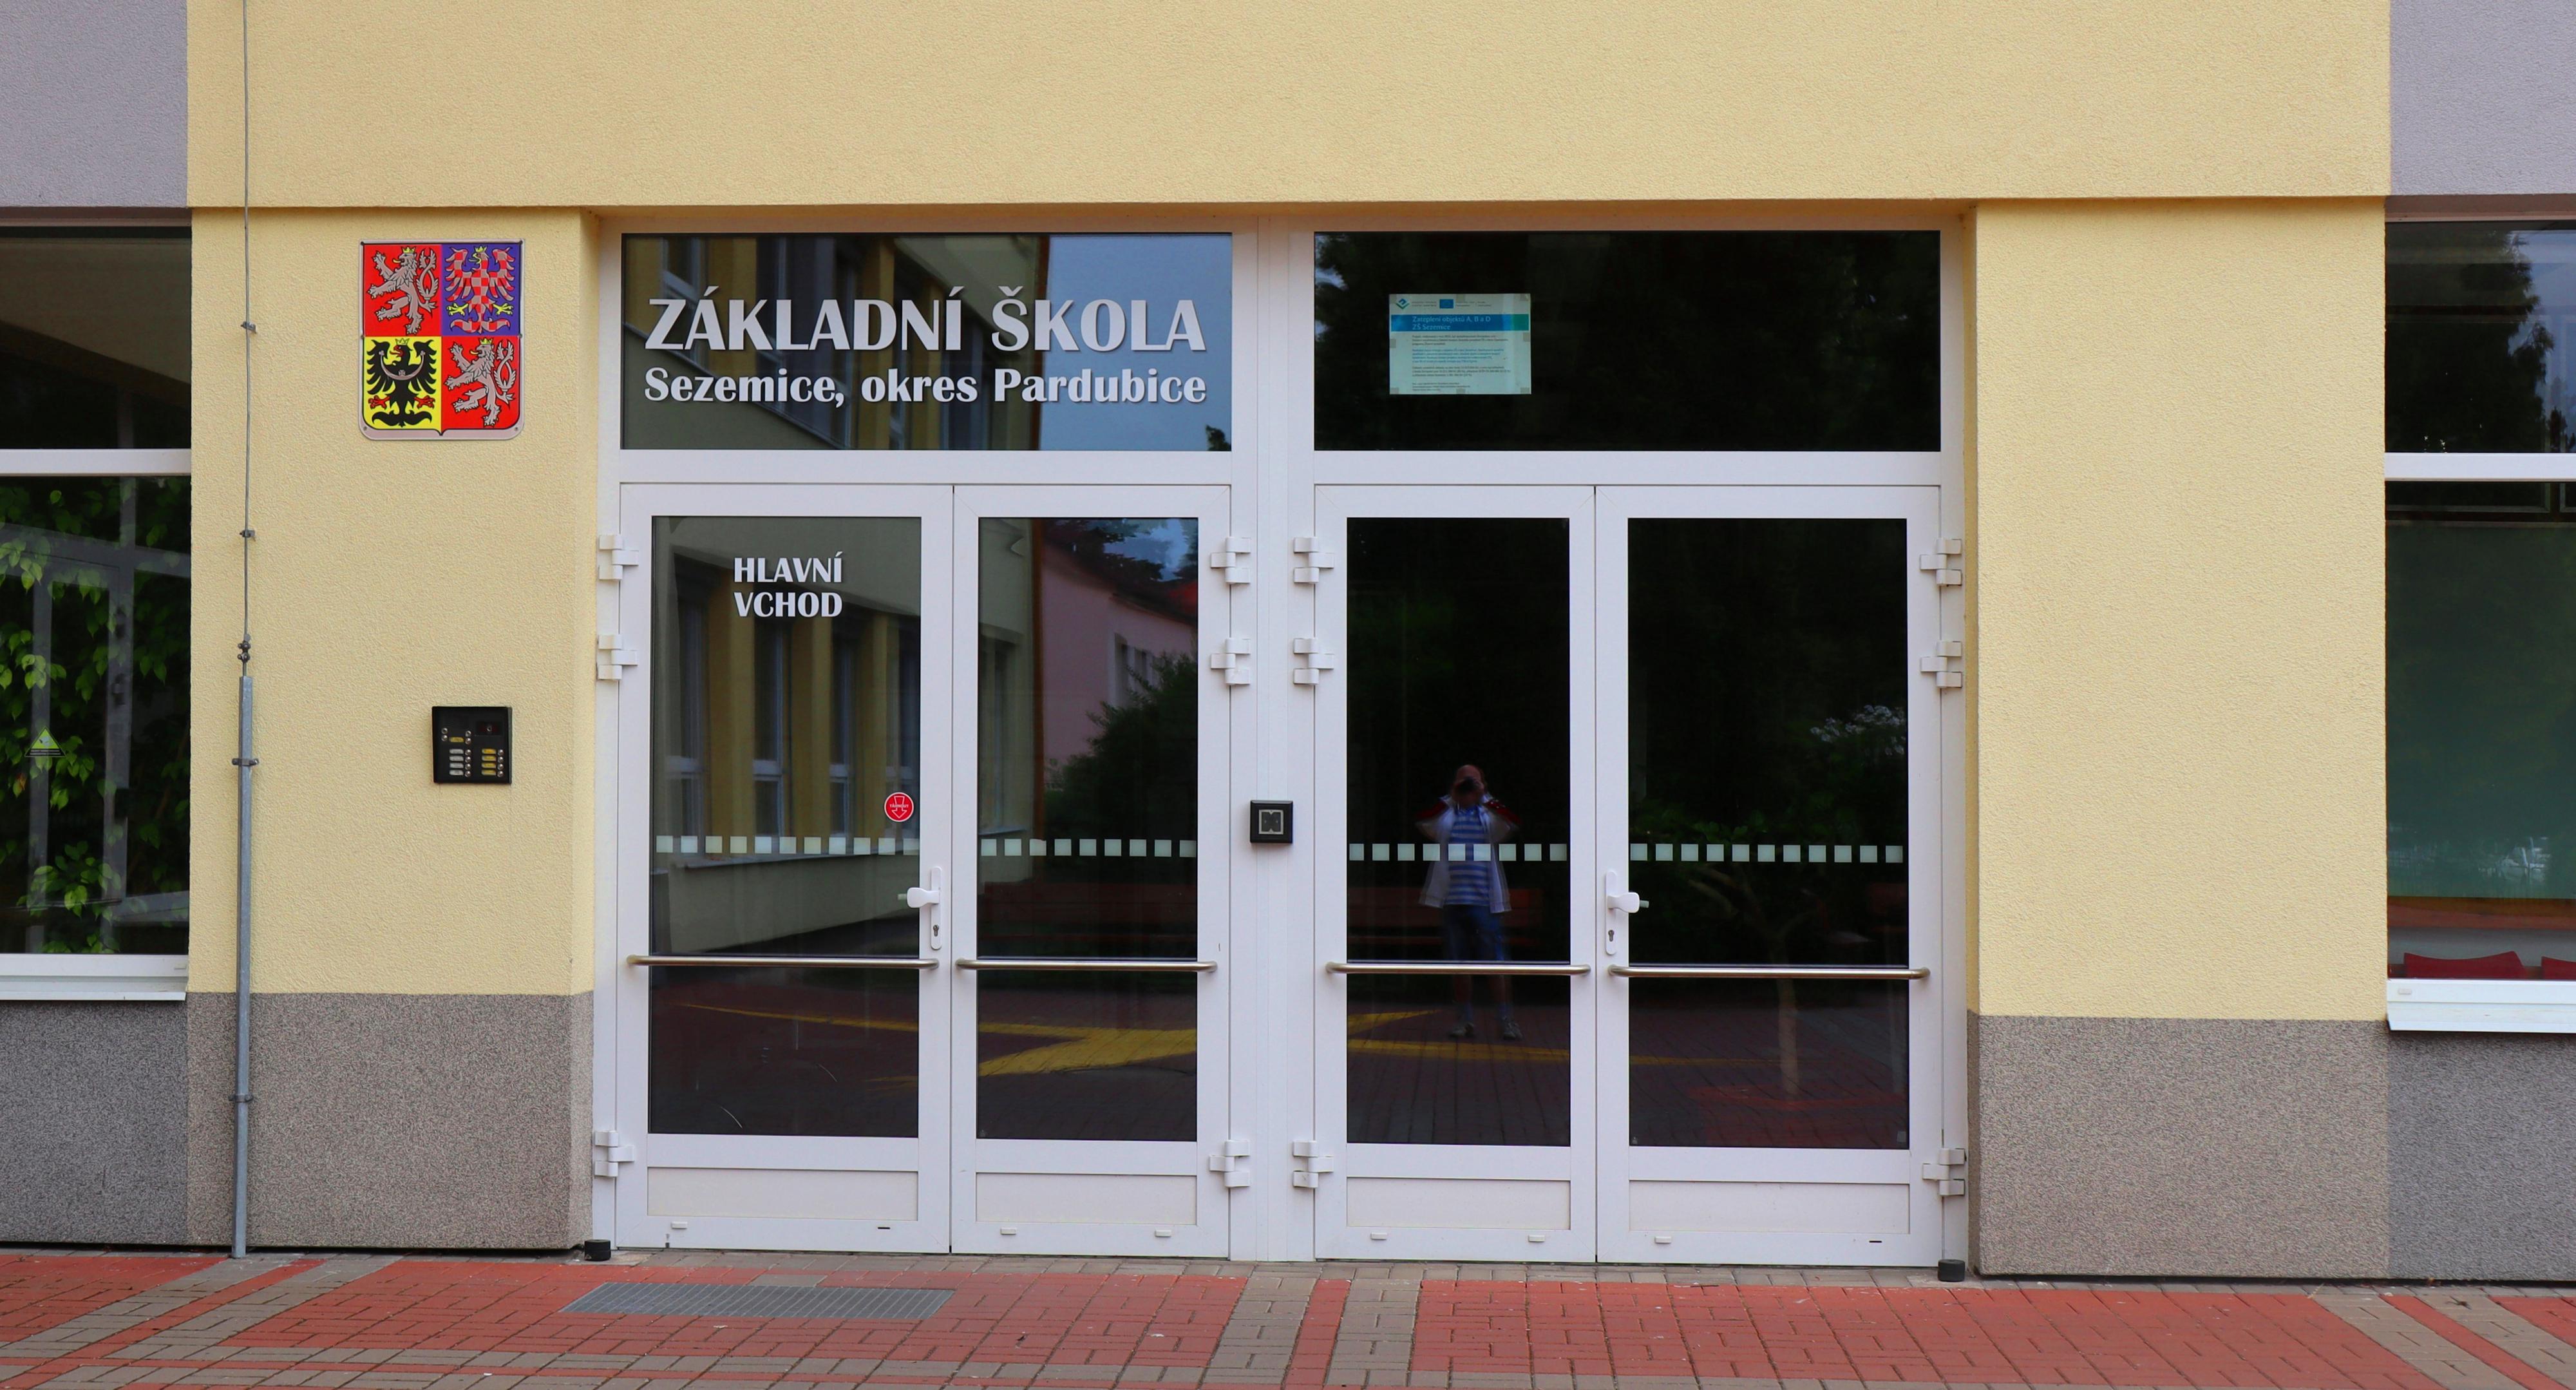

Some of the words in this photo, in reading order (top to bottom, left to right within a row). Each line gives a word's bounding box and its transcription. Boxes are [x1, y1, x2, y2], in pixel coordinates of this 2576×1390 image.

[645, 286, 963, 351] ZÁKLADNÍ
[992, 286, 1206, 352] ŠKOLA
[644, 367, 844, 408] Sezemice,
[861, 368, 978, 403] okres
[994, 368, 1206, 403] Pardubice
[734, 551, 843, 583] HLAVNÍ
[734, 591, 843, 618] VCHOD
